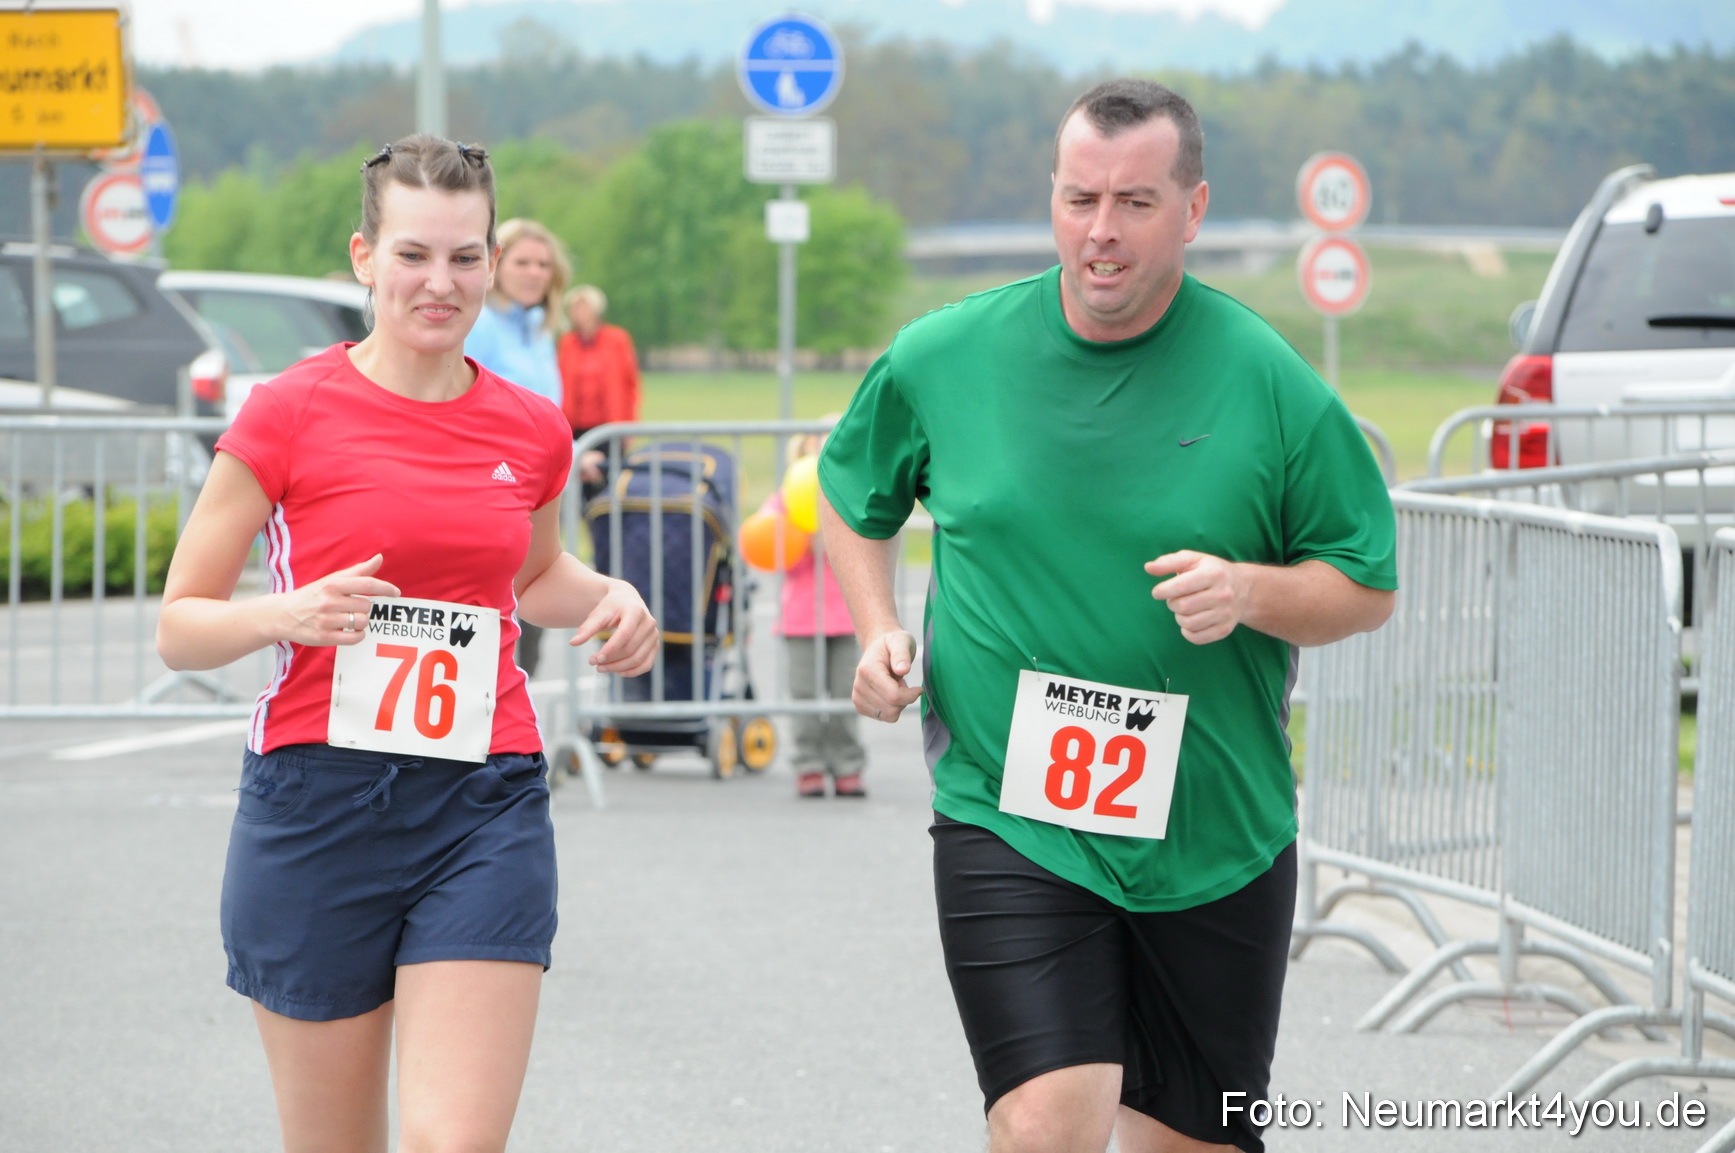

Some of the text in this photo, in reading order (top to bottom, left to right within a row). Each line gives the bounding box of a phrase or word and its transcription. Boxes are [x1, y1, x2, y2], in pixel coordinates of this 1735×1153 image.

[369, 604, 445, 627] MEYER
[368, 622, 445, 641] WERBUNG
[374, 643, 459, 740] 76
[1045, 681, 1122, 712] MEYER
[1044, 699, 1121, 725] WERBUNG
[1044, 725, 1147, 819] 82
